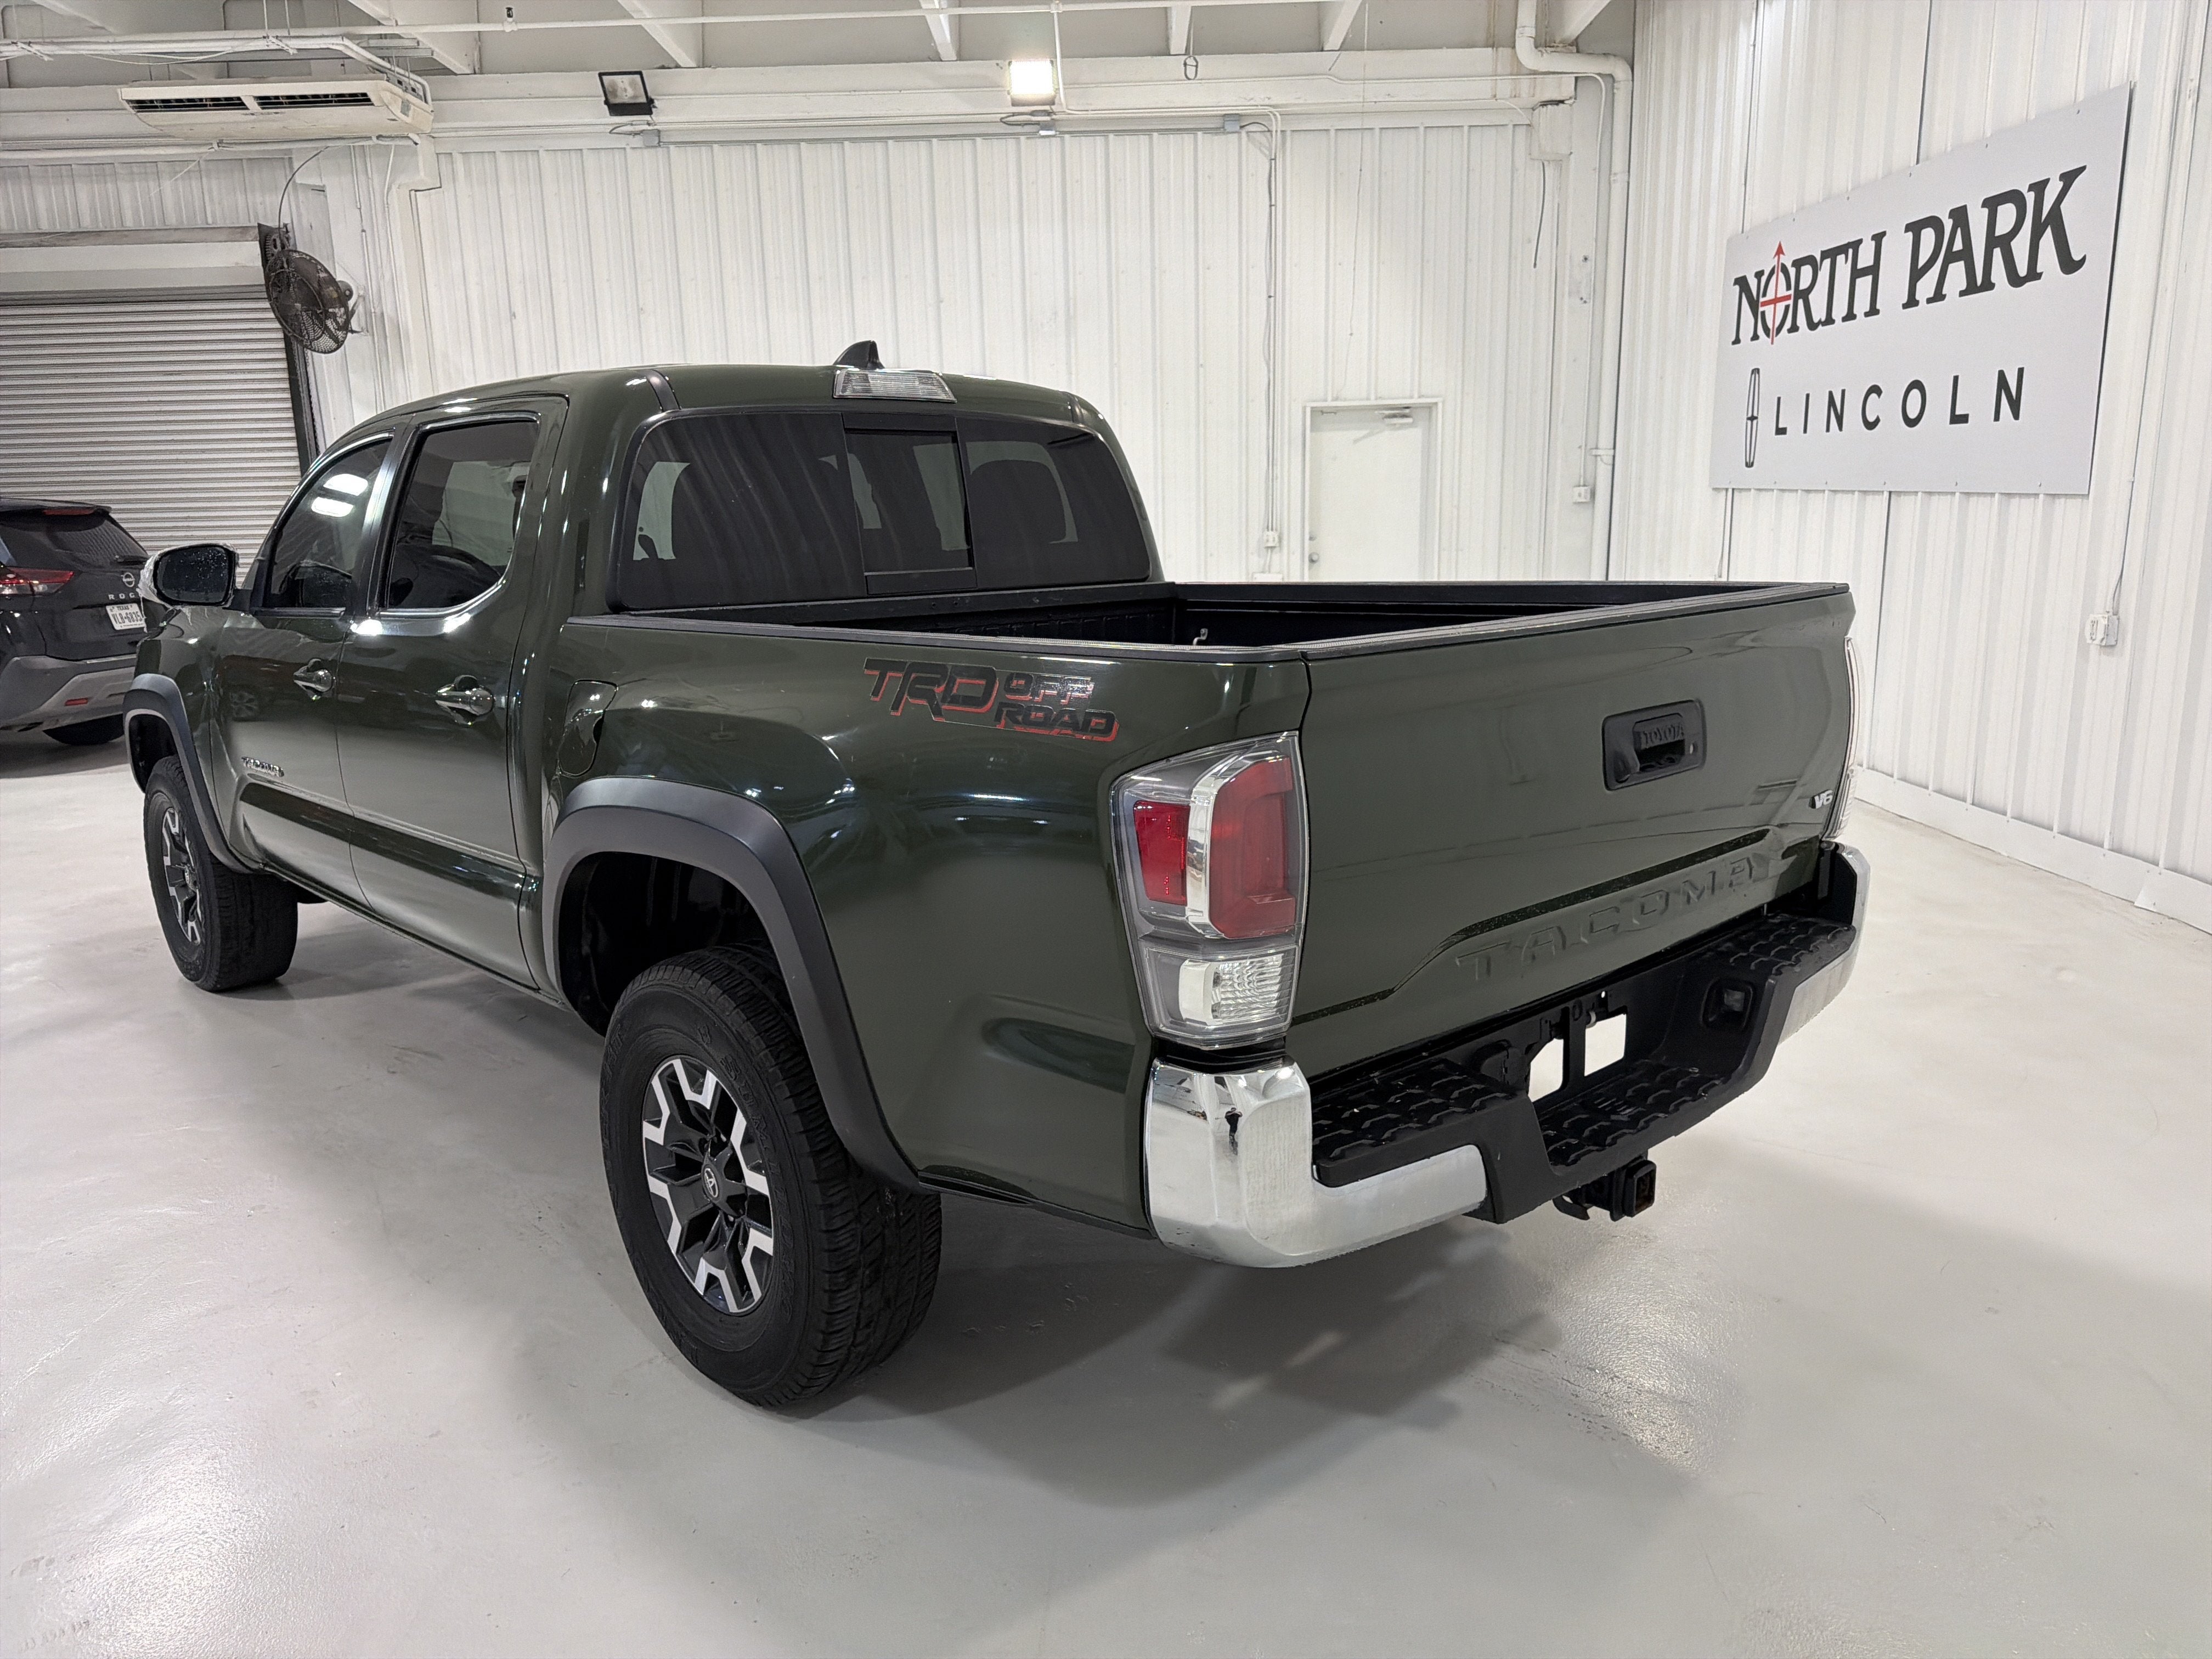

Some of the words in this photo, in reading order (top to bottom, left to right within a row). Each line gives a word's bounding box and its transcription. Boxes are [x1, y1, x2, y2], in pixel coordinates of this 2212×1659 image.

[1731, 230, 1887, 345] NORTH
[1901, 165, 2087, 310] PARK
[1774, 366, 2025, 436] LINCOLN
[863, 657, 998, 722] TRD
[1004, 672, 1095, 705] OFF
[994, 702, 1120, 742] ROAD
[1641, 724, 1685, 746] TOYOTA
[1812, 789, 1833, 809] V6
[1454, 854, 1757, 981] TACOMA
